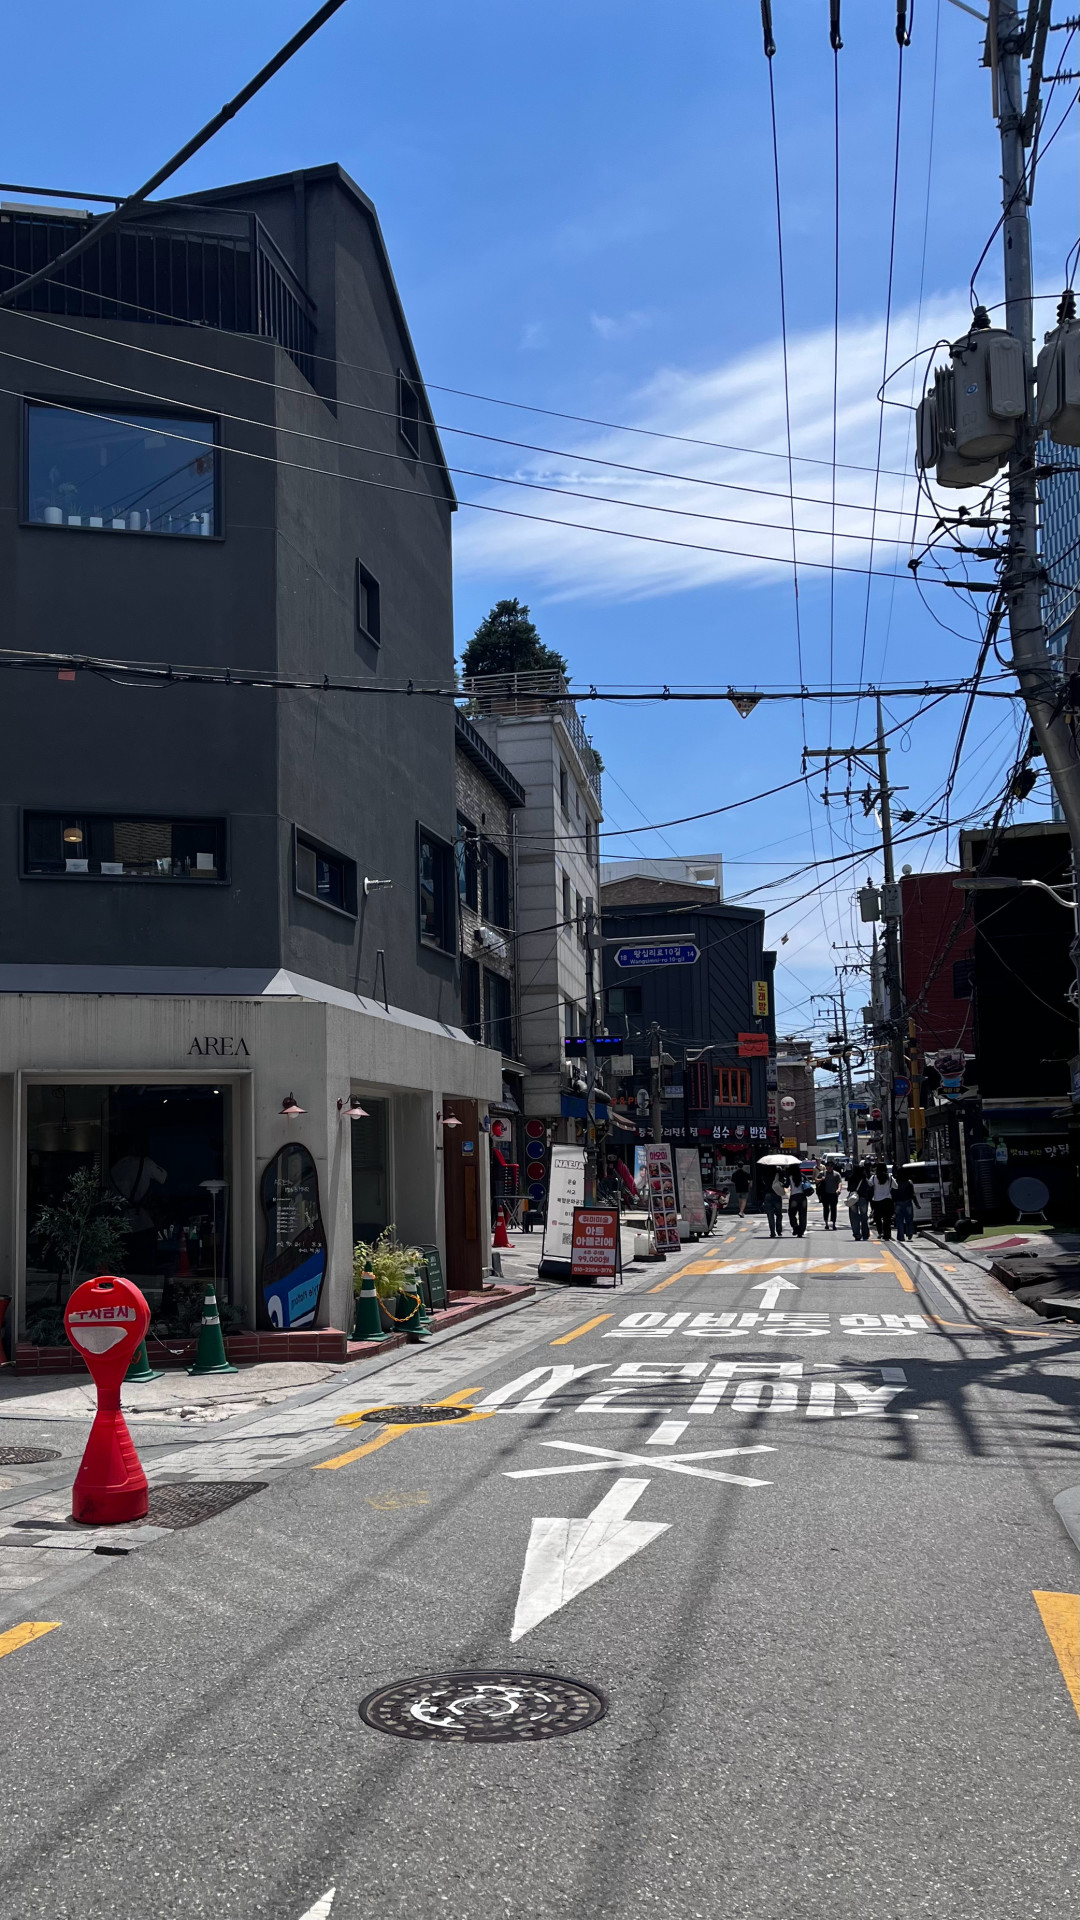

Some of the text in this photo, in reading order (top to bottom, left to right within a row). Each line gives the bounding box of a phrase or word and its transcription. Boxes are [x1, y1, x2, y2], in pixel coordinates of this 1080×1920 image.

[633, 948, 681, 958] 왕십리로10길
[757, 982, 767, 1011] 노래방
[187, 1036, 251, 1056] AREA
[713, 1126, 767, 1139] 성수 반점
[585, 1226, 605, 1236] 아트
[602, 1312, 929, 1338] 일방통행
[473, 1361, 919, 1420] 진입금지
